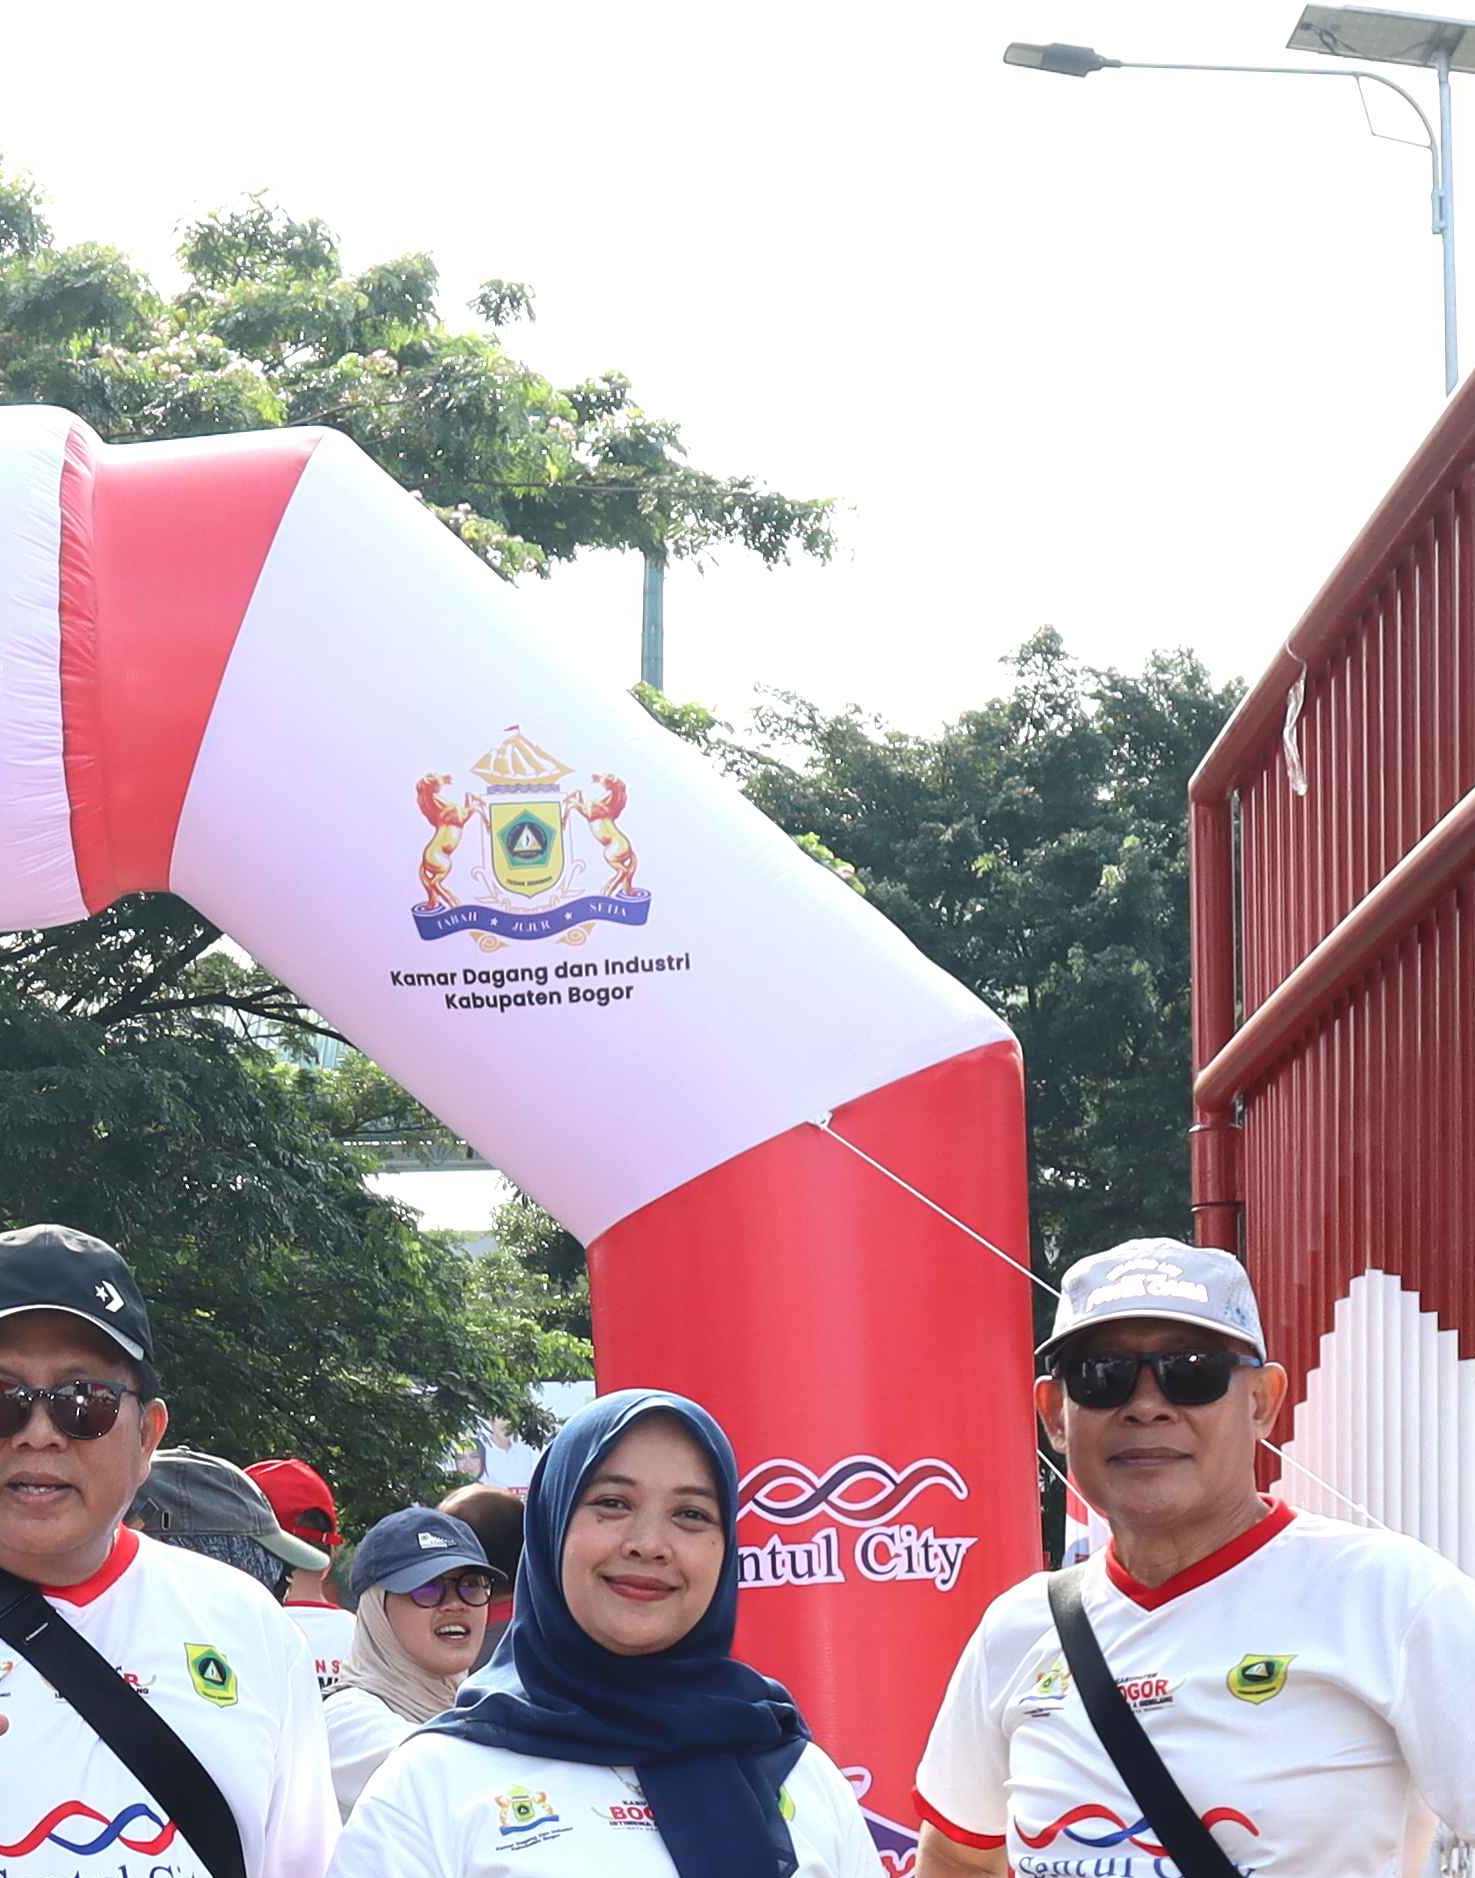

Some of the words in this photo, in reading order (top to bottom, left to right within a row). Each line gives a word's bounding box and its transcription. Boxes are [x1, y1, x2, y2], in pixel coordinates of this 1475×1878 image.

[390, 969, 457, 987] Kamar
[463, 963, 548, 988] Dagang
[554, 960, 598, 979] dan
[604, 952, 691, 976] Industri
[445, 987, 562, 1012] Kabupaten
[568, 983, 634, 1006] Bogor
[738, 1531, 839, 1583] ntul
[860, 1527, 966, 1589] City
